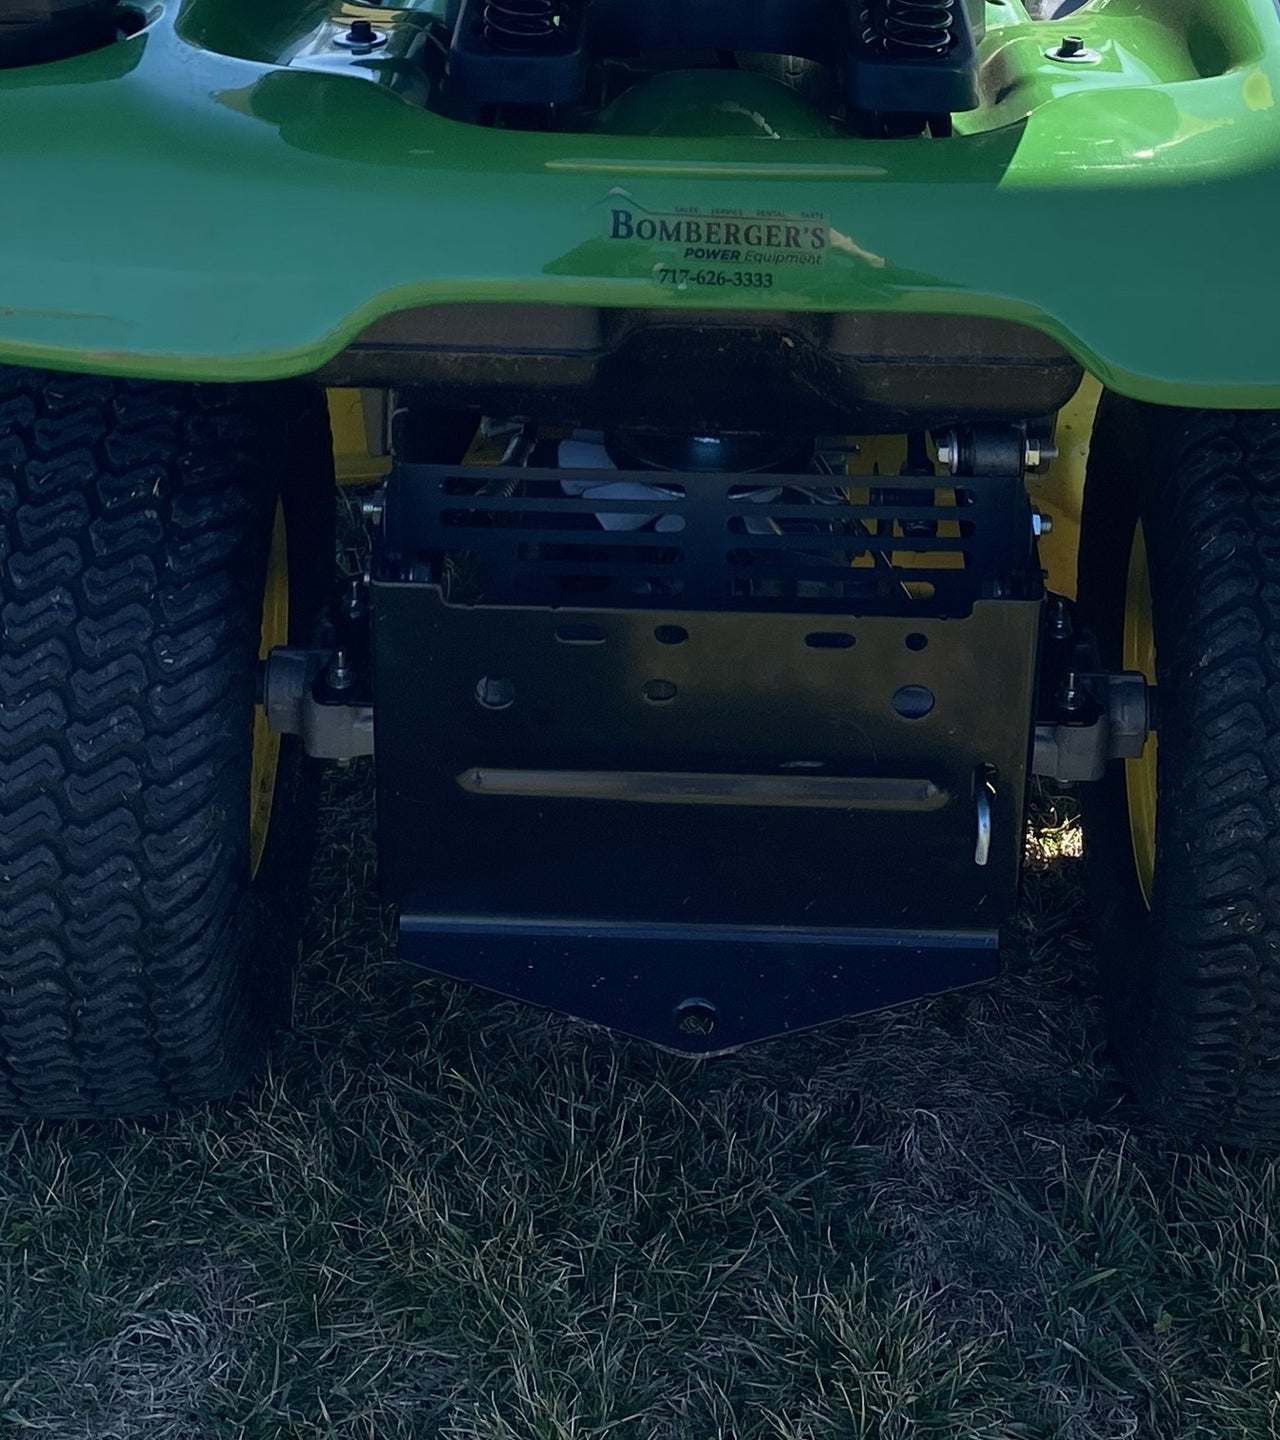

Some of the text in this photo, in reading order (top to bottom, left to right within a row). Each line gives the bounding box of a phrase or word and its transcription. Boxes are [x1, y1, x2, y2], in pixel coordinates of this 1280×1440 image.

[610, 209, 825, 249] BOMBERGER'S
[683, 247, 822, 266] POWER Equipment
[659, 267, 773, 289] 717-626-3333
